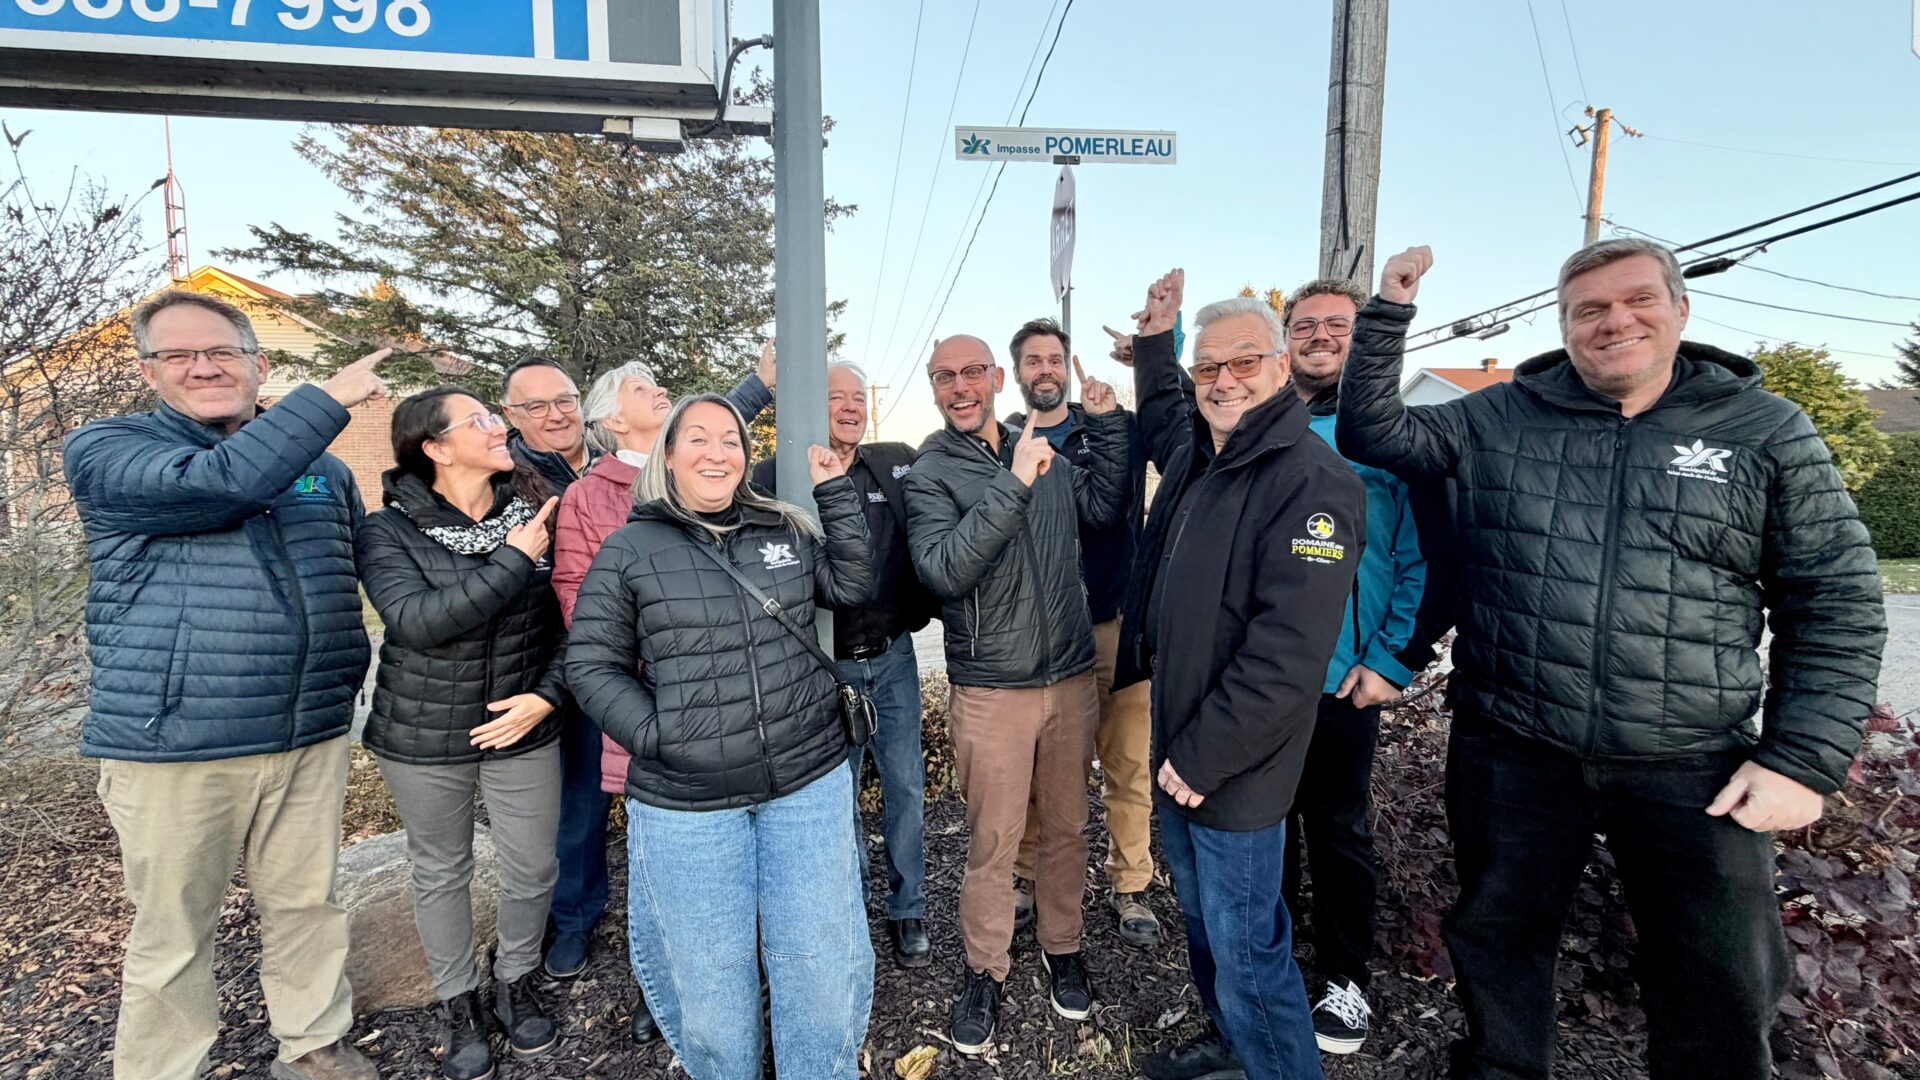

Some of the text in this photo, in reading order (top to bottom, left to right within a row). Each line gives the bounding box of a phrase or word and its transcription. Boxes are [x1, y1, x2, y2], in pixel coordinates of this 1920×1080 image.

[14, 0, 431, 37] -998
[997, 136, 1172, 157] Impasse POMERLEAU
[1291, 539, 1335, 548] DOMAINE
[1291, 545, 1344, 560] POMMIERS
